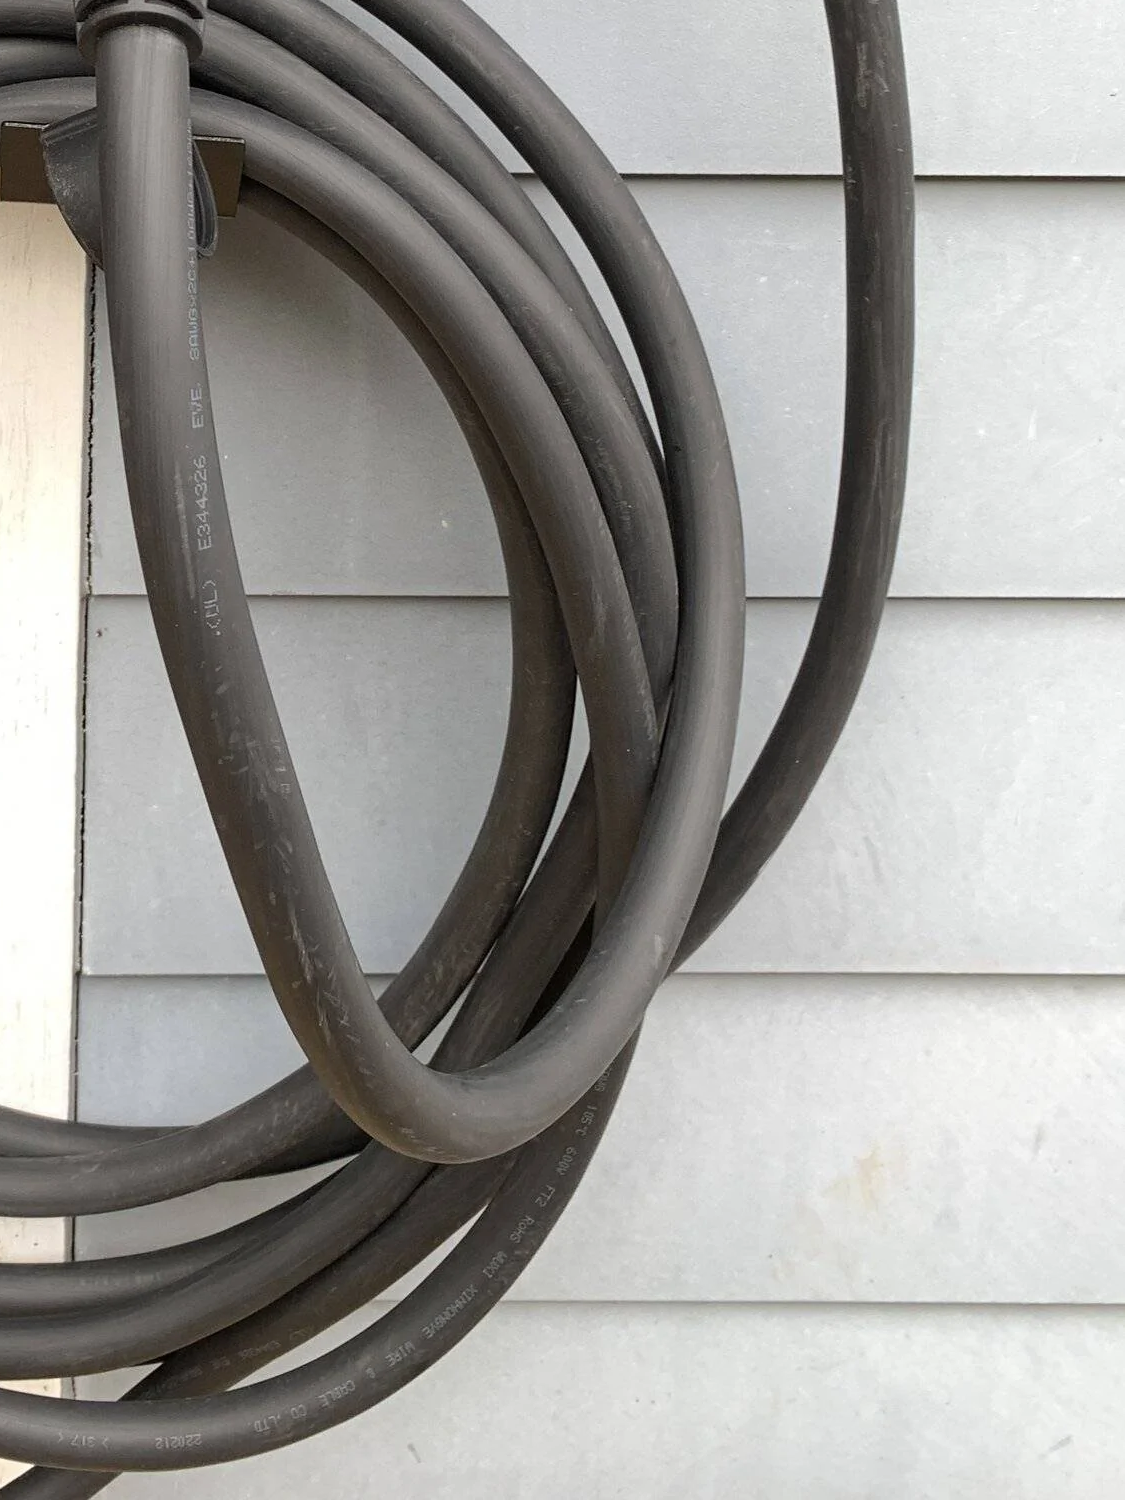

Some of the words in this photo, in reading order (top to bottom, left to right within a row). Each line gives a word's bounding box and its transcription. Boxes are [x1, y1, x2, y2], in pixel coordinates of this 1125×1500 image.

[193, 455, 213, 551] E344326
[557, 1145, 577, 1177] 600V
[534, 1184, 556, 1208] FT2
[509, 1214, 536, 1244] RoHS
[316, 1379, 356, 1408] CABLE
